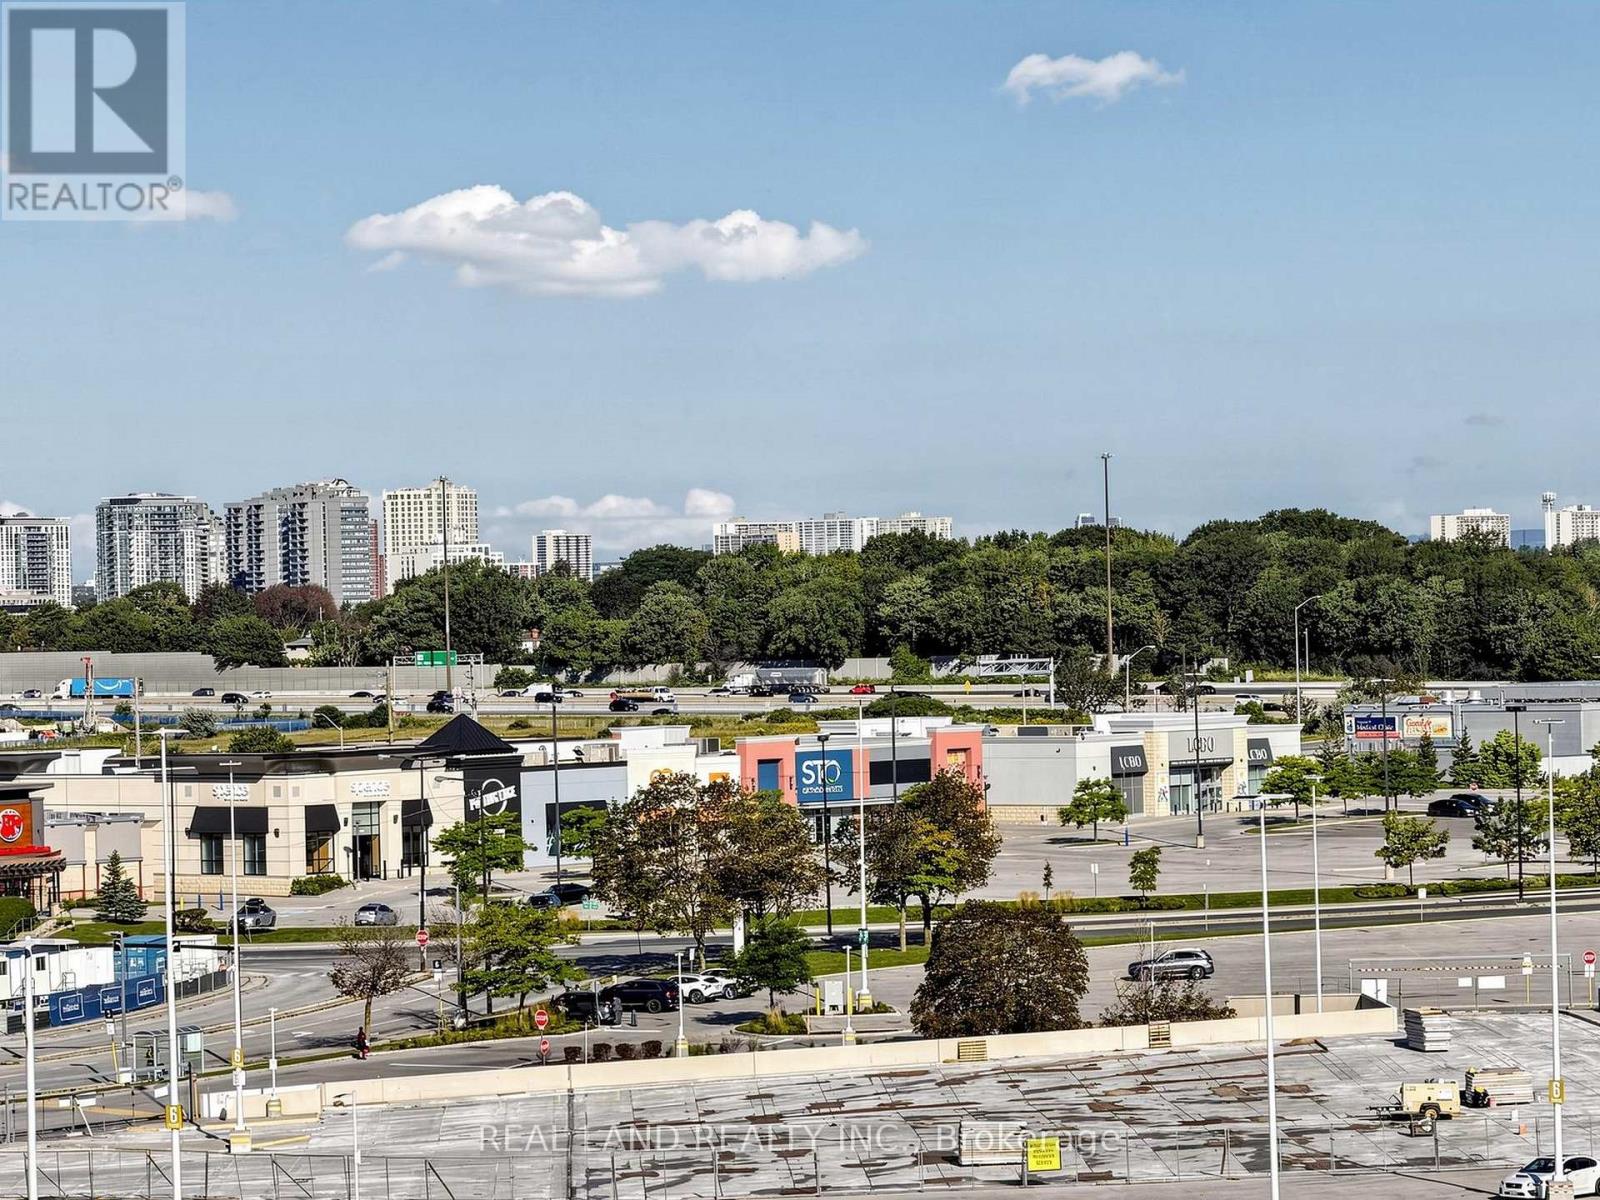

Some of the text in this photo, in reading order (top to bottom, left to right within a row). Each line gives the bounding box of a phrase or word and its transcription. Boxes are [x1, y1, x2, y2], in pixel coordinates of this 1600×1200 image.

[1119, 755, 1142, 770] LCBO
[1553, 1081, 1560, 1098] 6
[169, 1106, 178, 1123] 6
